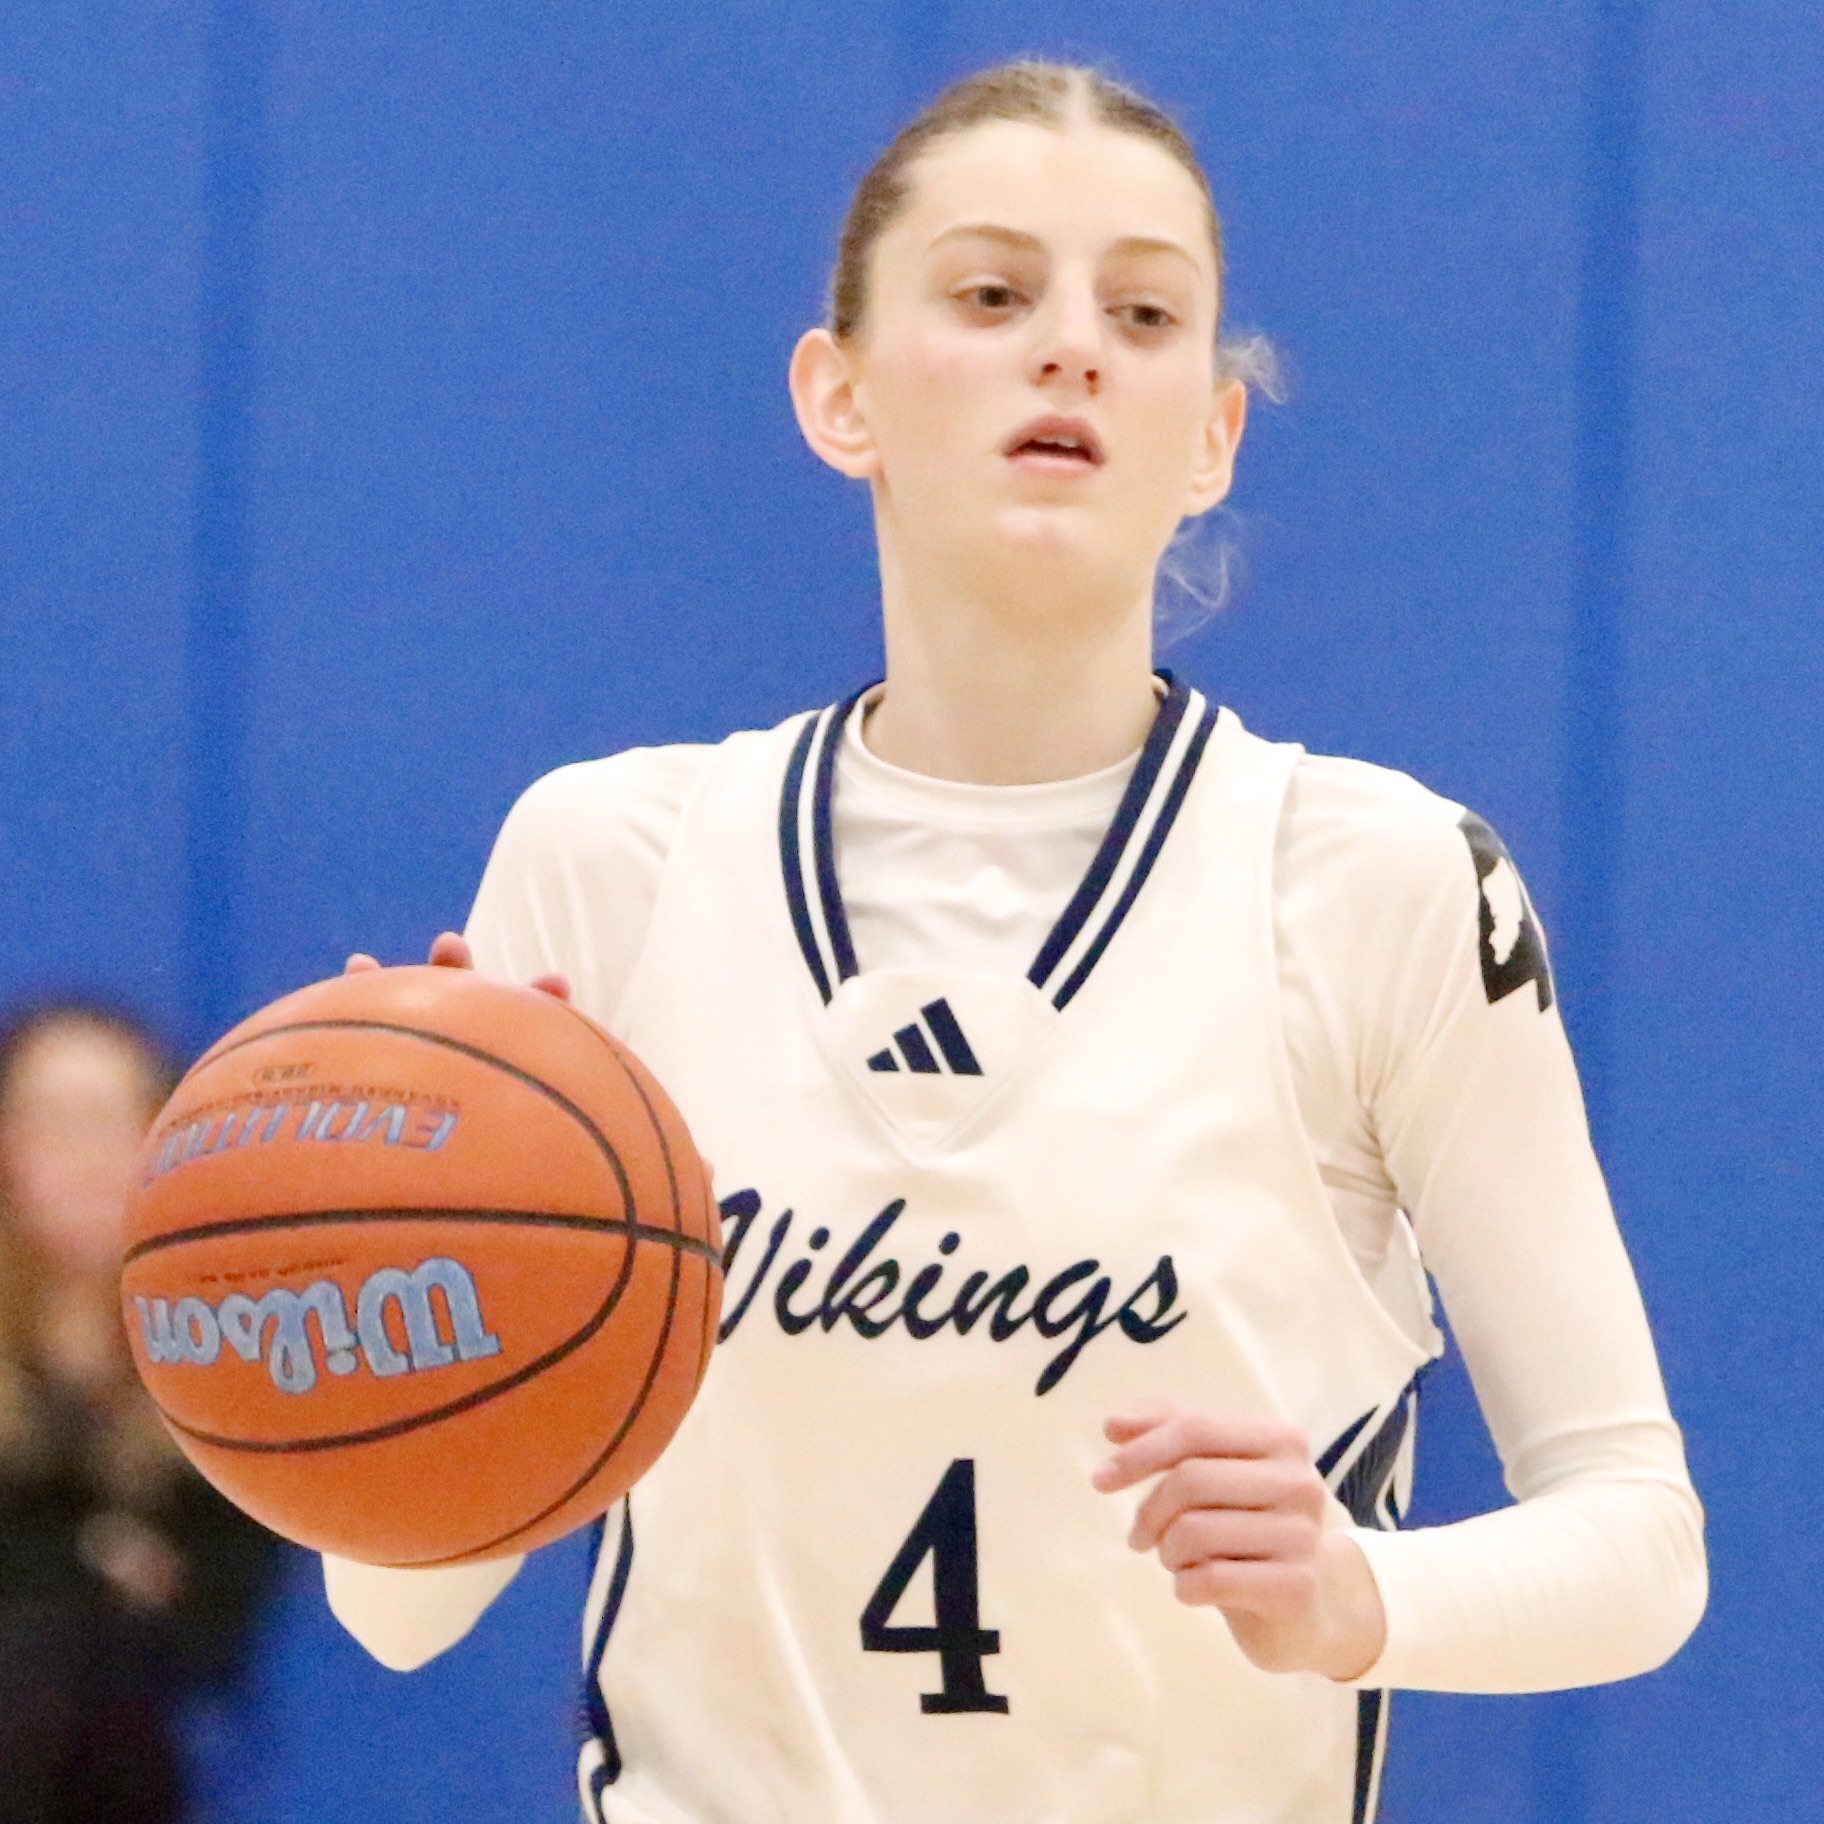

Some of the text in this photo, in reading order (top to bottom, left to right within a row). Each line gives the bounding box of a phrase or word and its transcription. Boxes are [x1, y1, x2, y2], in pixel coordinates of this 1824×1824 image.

[133, 1256, 502, 1396] Wilson
[717, 1187, 1188, 1397] Vikings
[858, 1457, 1010, 1716] 4
